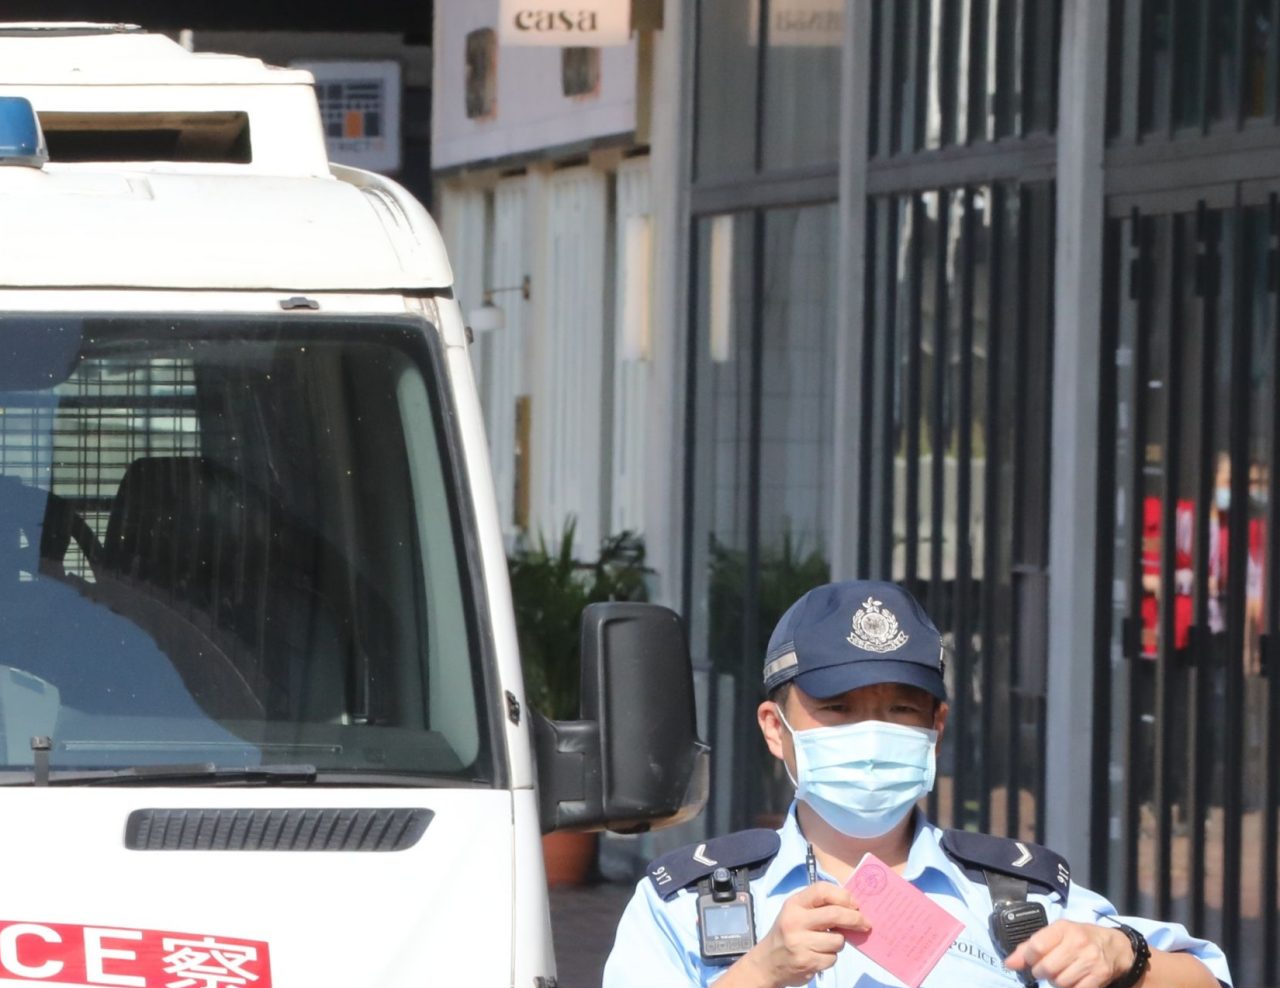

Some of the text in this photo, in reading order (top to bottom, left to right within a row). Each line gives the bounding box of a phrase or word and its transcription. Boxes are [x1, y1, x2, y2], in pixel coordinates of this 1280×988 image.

[513, 10, 597, 32] casa
[652, 866, 673, 886] 917
[1056, 863, 1070, 888] 917
